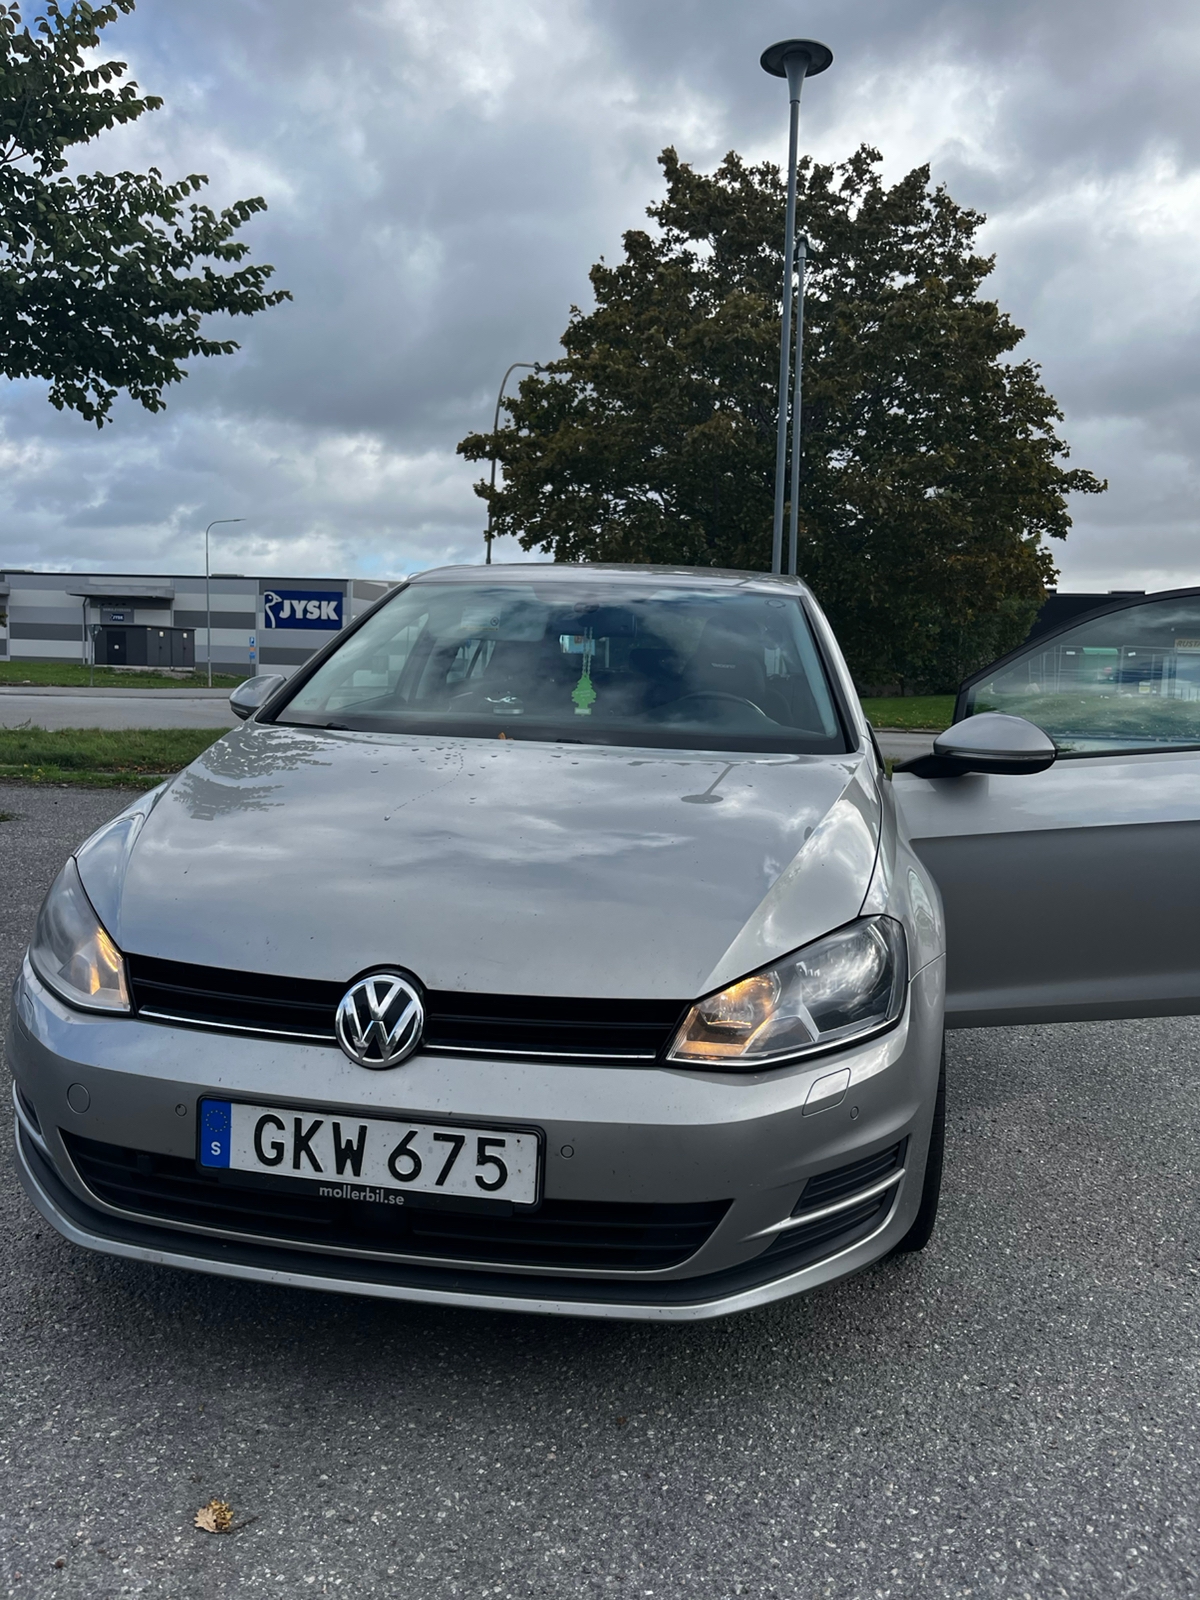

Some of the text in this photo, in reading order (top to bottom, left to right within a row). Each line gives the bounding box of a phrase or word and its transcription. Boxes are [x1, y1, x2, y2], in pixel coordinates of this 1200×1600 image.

[279, 599, 339, 621] JYSK
[210, 1141, 222, 1156] S
[253, 1113, 509, 1192] GKW 675
[318, 1184, 405, 1206] mollerbil.se
